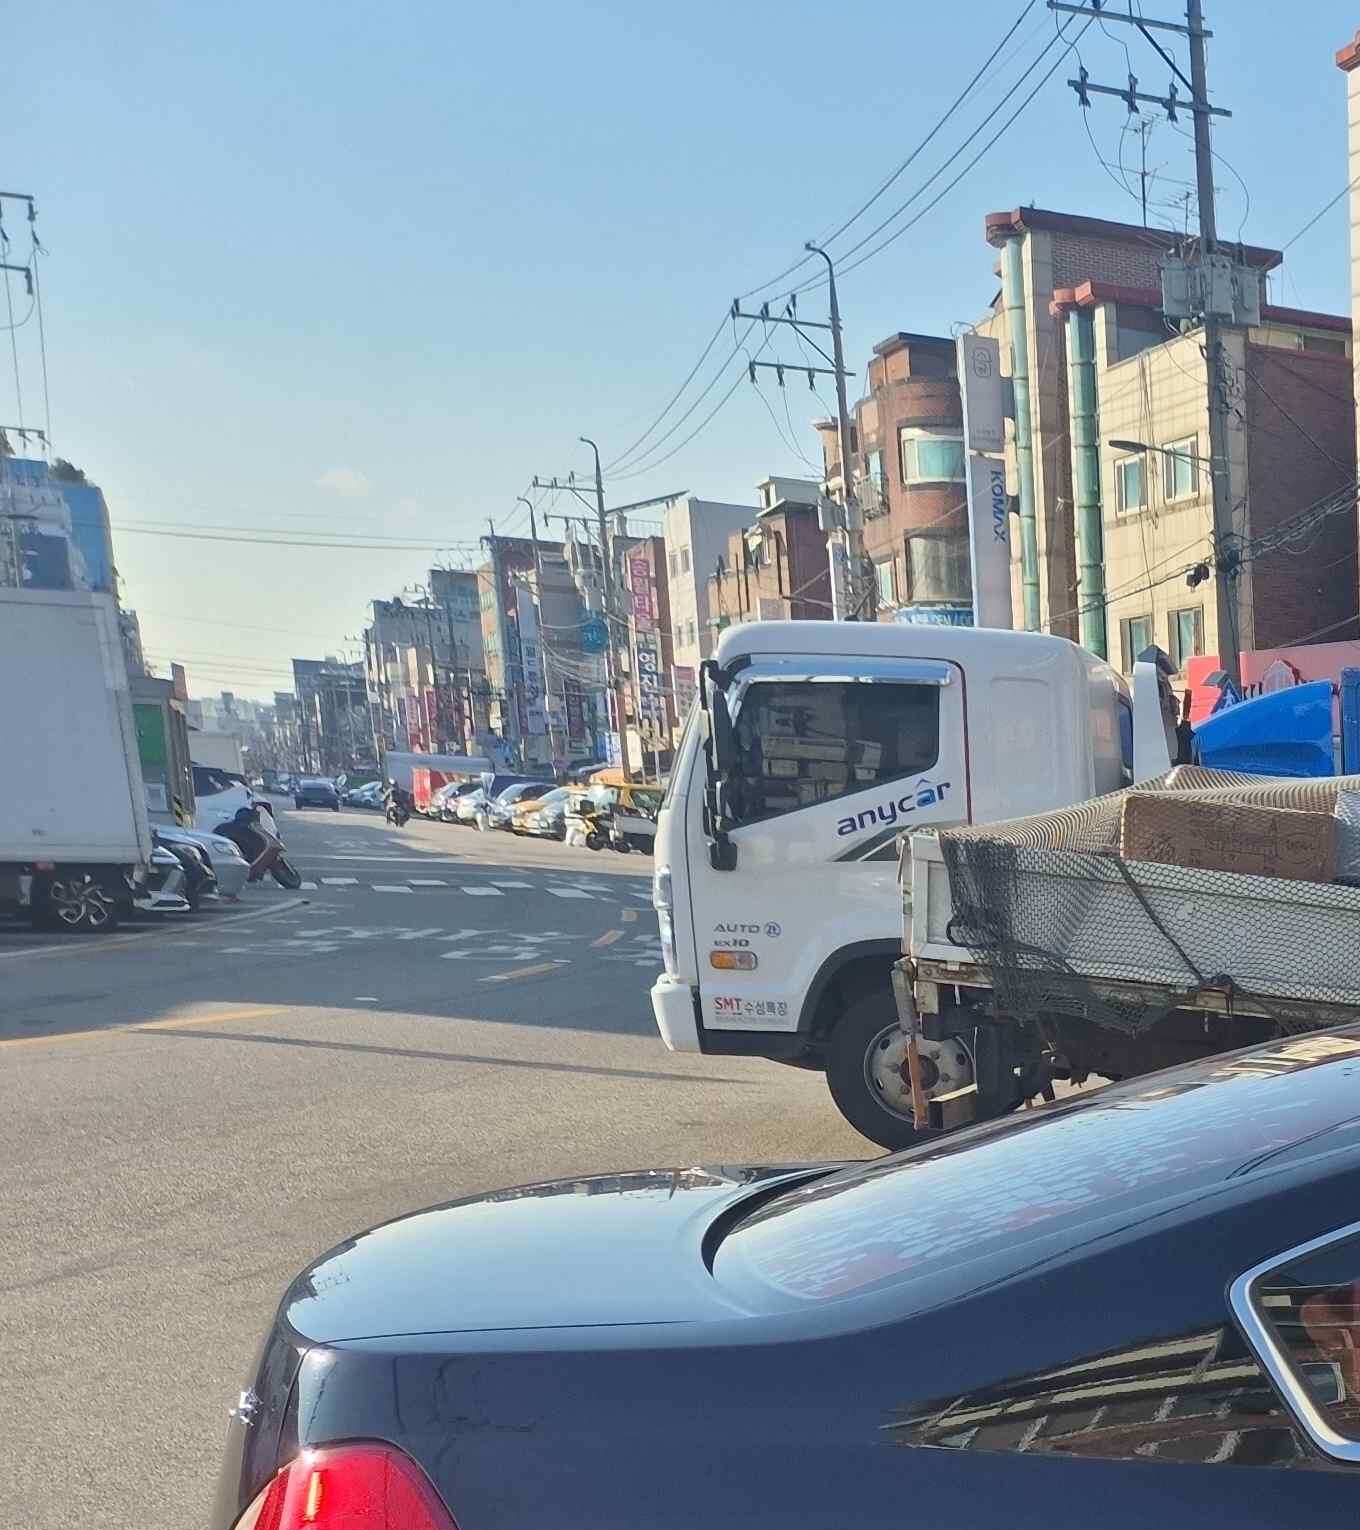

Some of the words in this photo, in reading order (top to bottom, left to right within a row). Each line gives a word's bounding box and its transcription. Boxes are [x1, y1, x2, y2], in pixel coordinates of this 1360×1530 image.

[990, 469, 1006, 544] KOMAX
[838, 778, 951, 836] anycar
[713, 923, 760, 934] AUTO
[714, 997, 742, 1012] SMT
